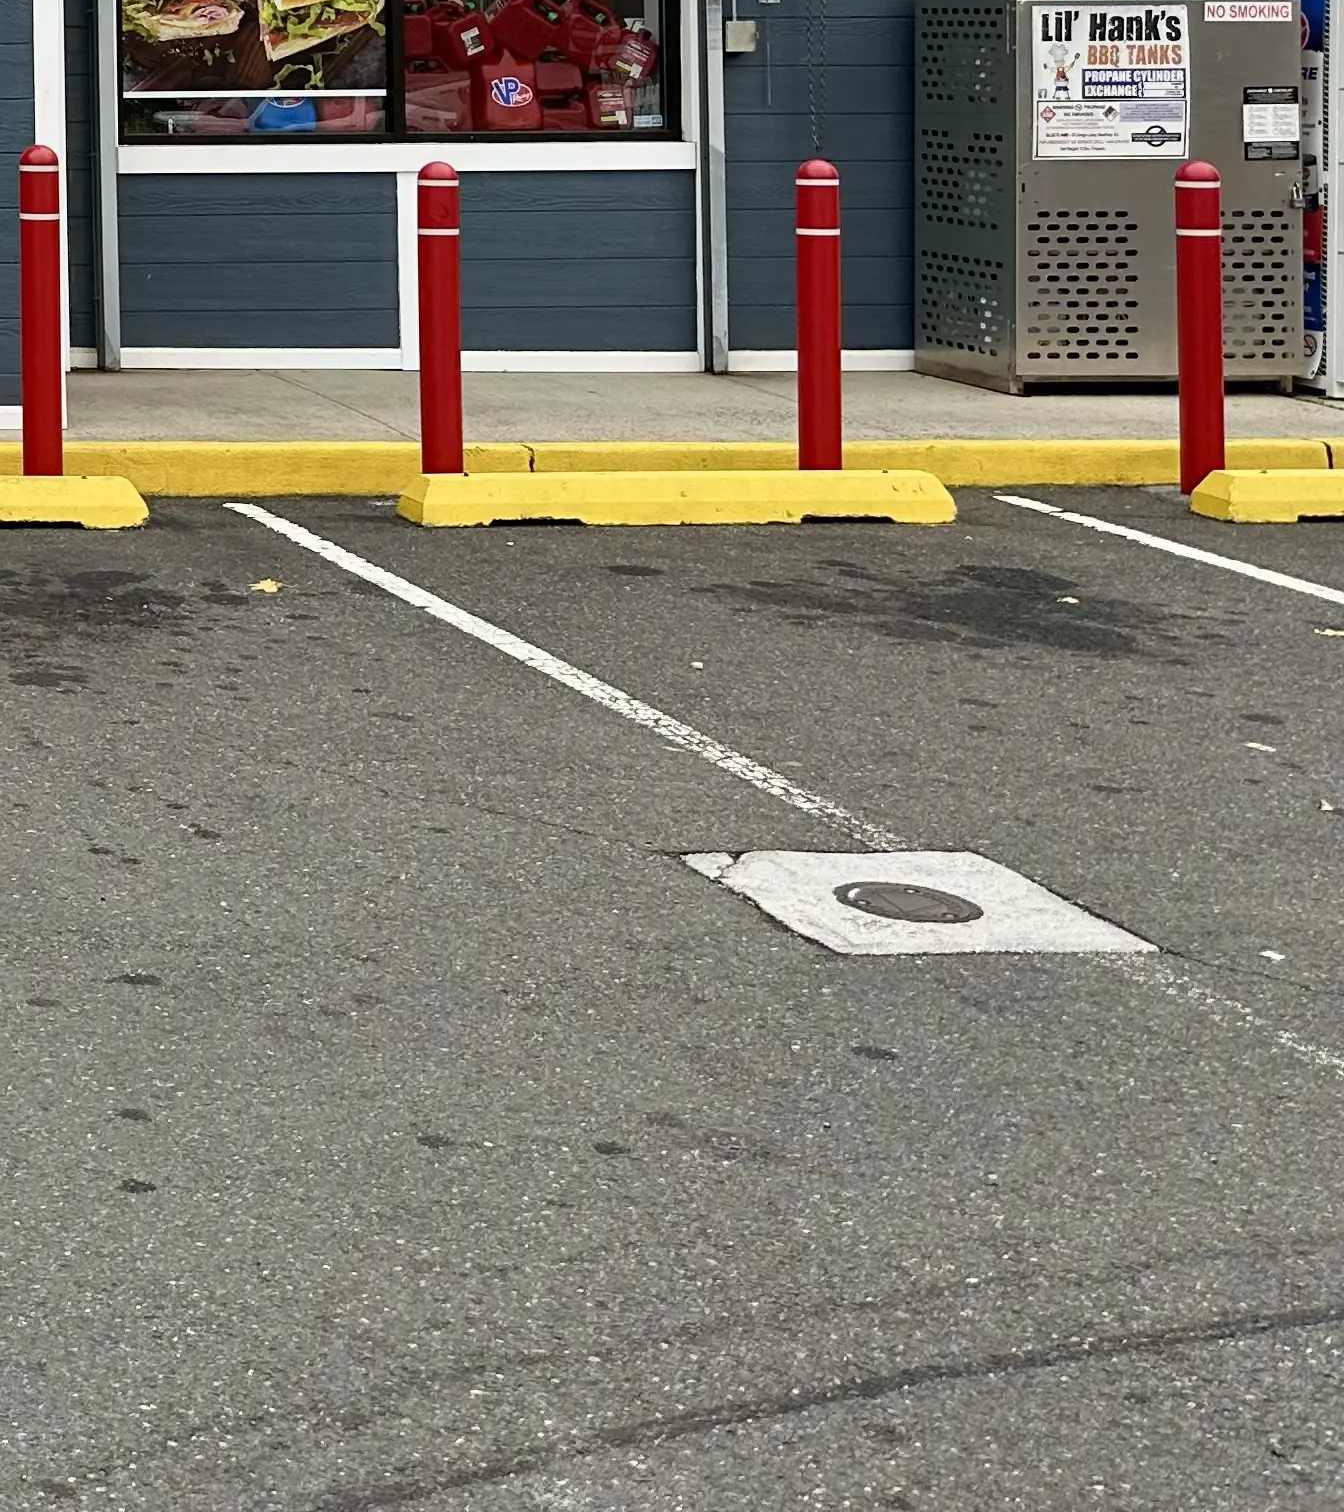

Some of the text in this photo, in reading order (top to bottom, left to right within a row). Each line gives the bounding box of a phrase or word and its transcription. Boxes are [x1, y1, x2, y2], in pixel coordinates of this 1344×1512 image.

[1207, 5, 1290, 18] NO SMOKING
[1089, 9, 1182, 42] Hank's
[1087, 45, 1182, 67] BBQ TANKS
[1084, 70, 1184, 82] PROPANE CYLINDER
[491, 77, 519, 105] VP
